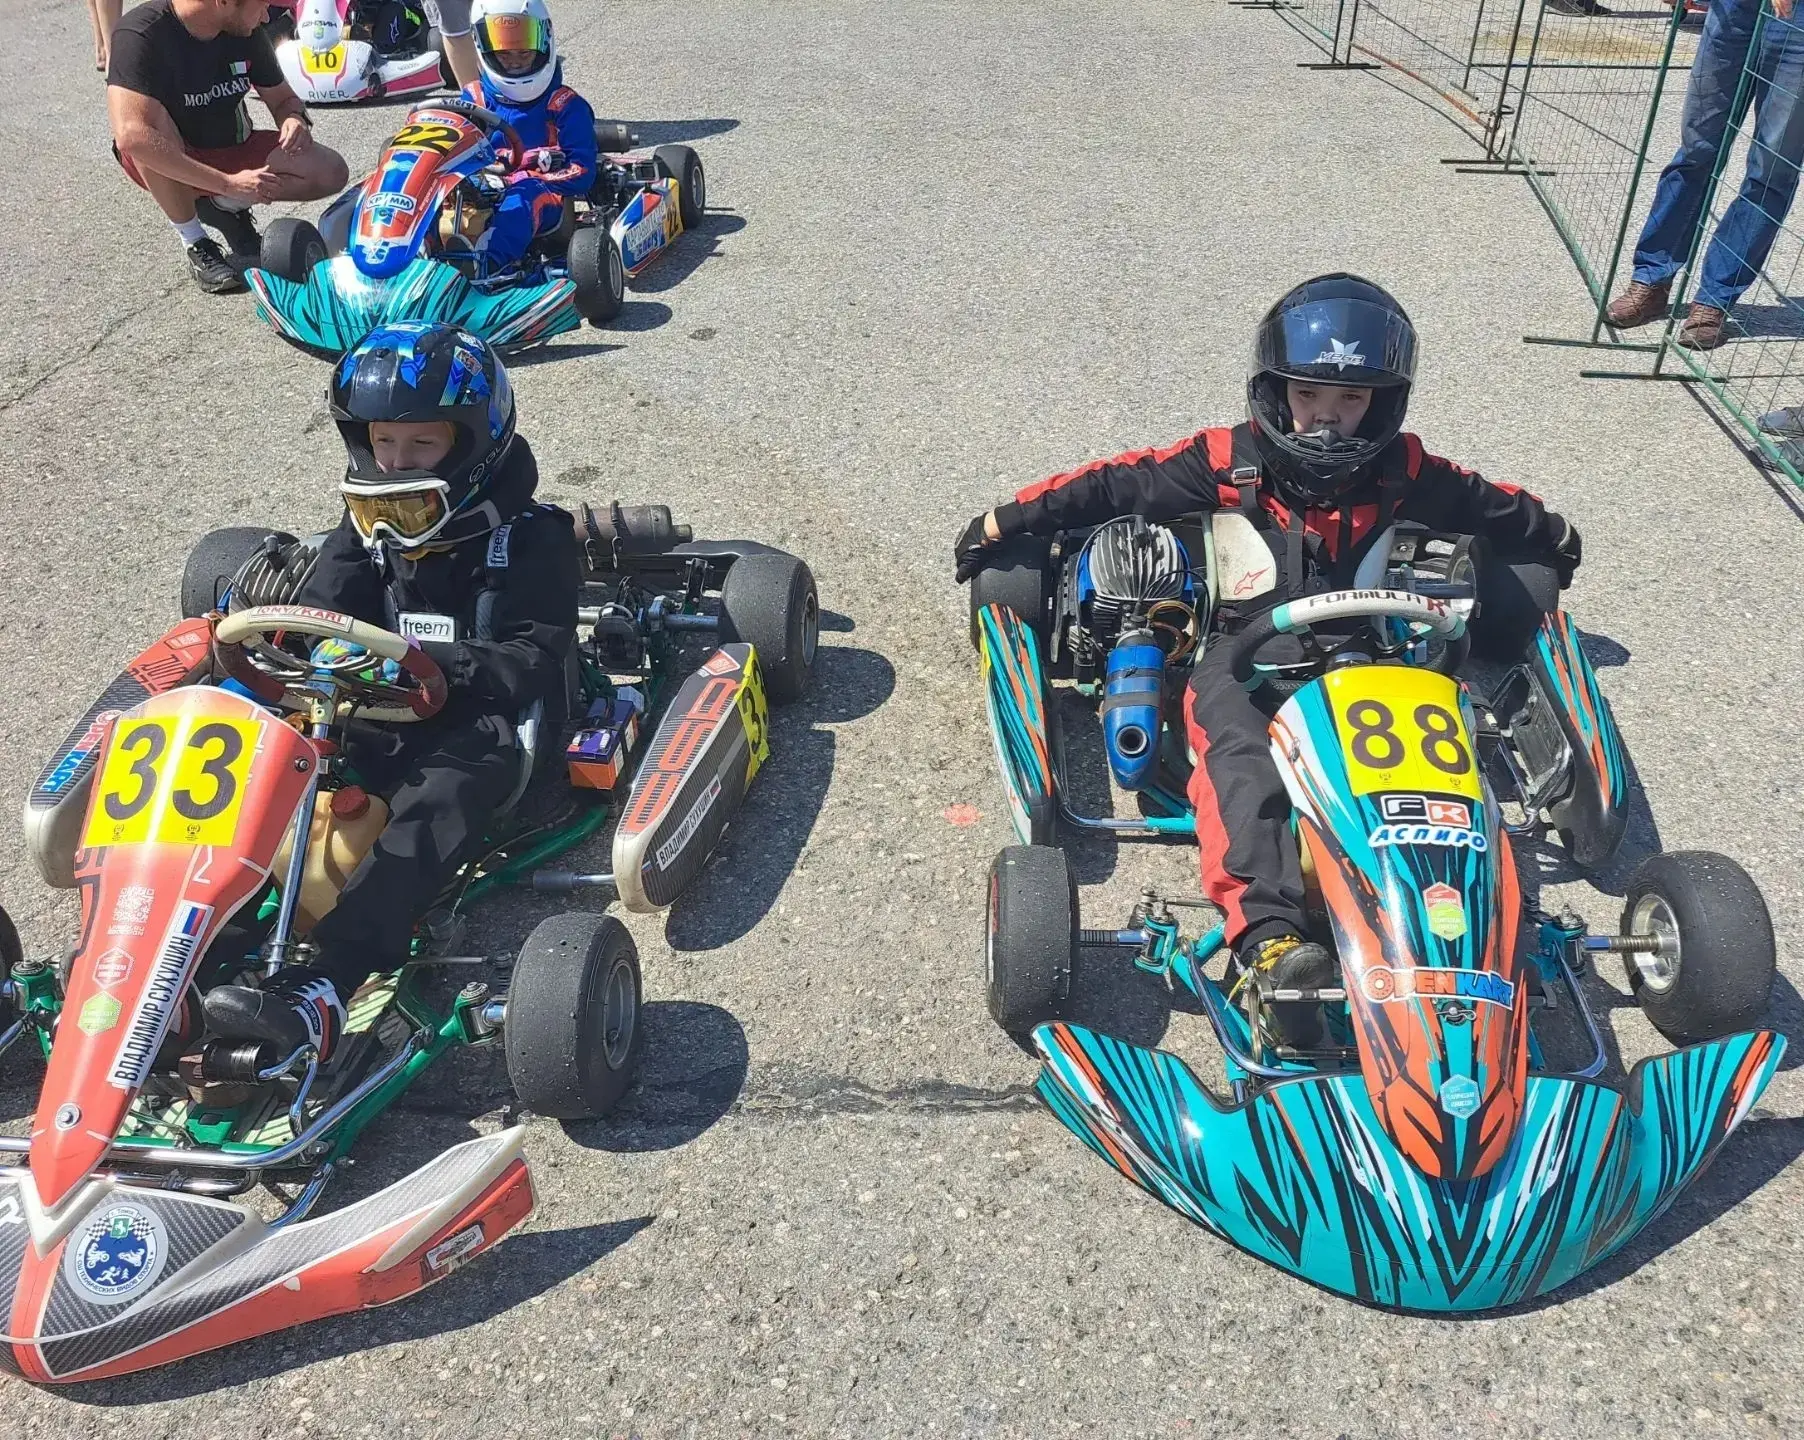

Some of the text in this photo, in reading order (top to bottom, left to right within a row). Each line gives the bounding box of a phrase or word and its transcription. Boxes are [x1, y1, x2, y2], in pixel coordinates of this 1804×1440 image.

[311, 51, 337, 69] 10
[308, 90, 349, 99] RIVER
[390, 126, 465, 158] 22
[490, 525, 508, 565] freem
[1310, 590, 1421, 607] FORMULA
[402, 617, 450, 636] freem
[1346, 699, 1471, 776] 88
[104, 722, 244, 821] 33
[1372, 826, 1486, 850] АСПИРО
[114, 1002, 165, 1082] ВЛАДИМИР
[147, 935, 194, 1003] СУХУШИН
